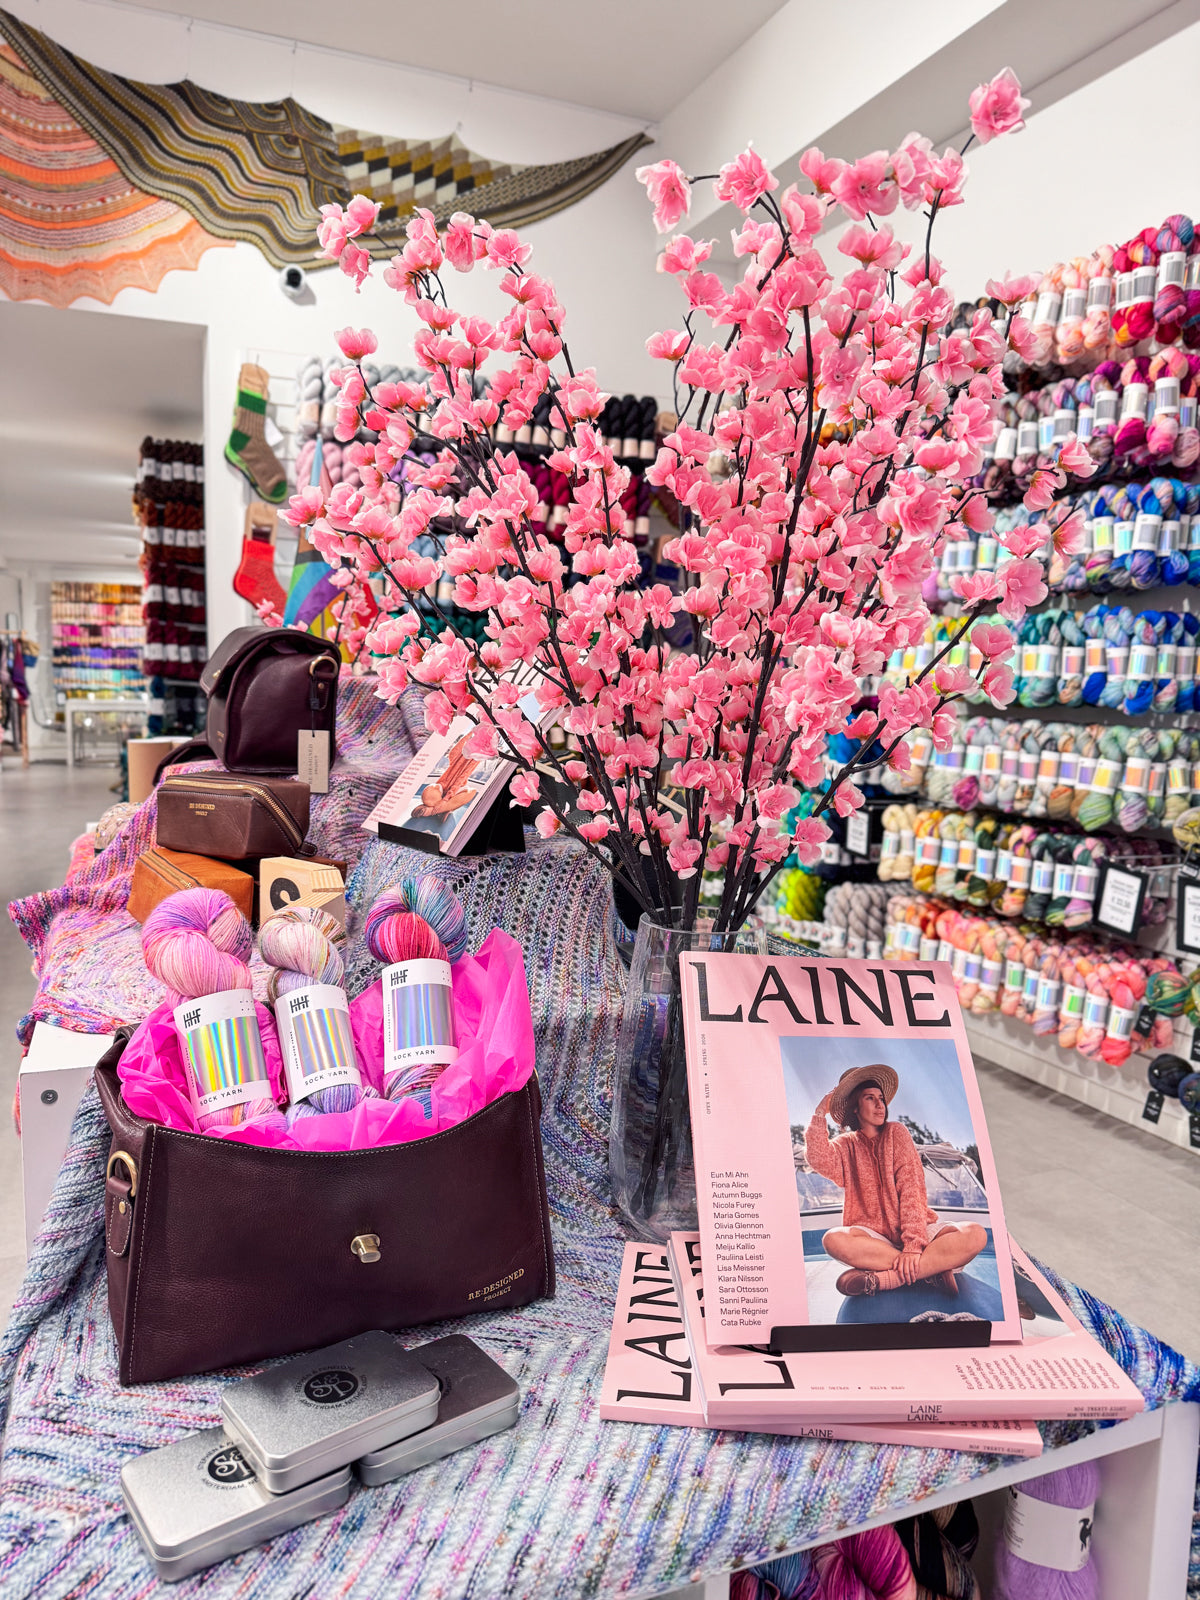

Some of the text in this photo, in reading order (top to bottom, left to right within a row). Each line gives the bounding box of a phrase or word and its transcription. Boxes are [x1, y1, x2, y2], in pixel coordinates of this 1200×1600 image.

[688, 961, 952, 1027] LAINE
[305, 1075, 324, 1085] SOCK
[200, 1088, 242, 1106] SOCK YARN
[484, 1286, 511, 1301] PROJECT
[616, 1251, 692, 1401] LAINE
[910, 1404, 943, 1414] LAINE
[801, 1427, 834, 1438] LAINE
